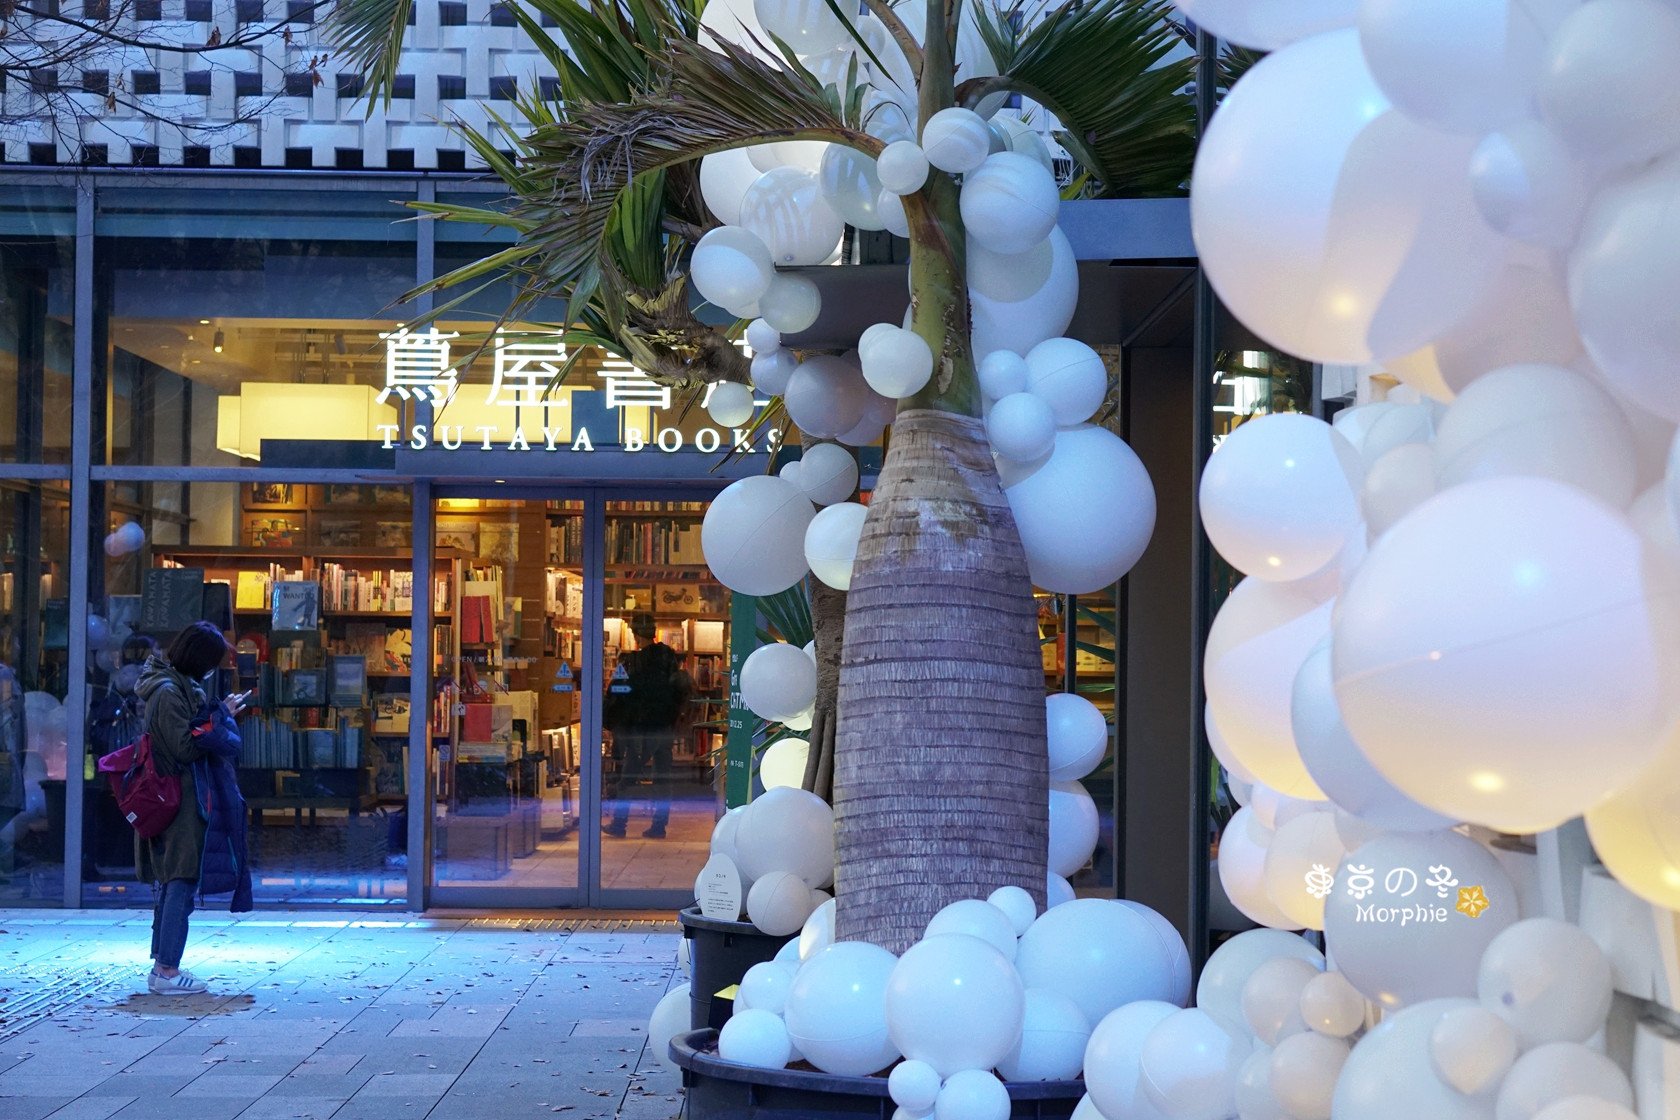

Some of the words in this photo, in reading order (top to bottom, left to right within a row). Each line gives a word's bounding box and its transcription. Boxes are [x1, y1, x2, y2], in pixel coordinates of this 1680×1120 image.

[375, 322, 772, 410] 蔦屋書
[376, 424, 595, 451] TSUTAYA
[623, 427, 783, 453] BOOKS
